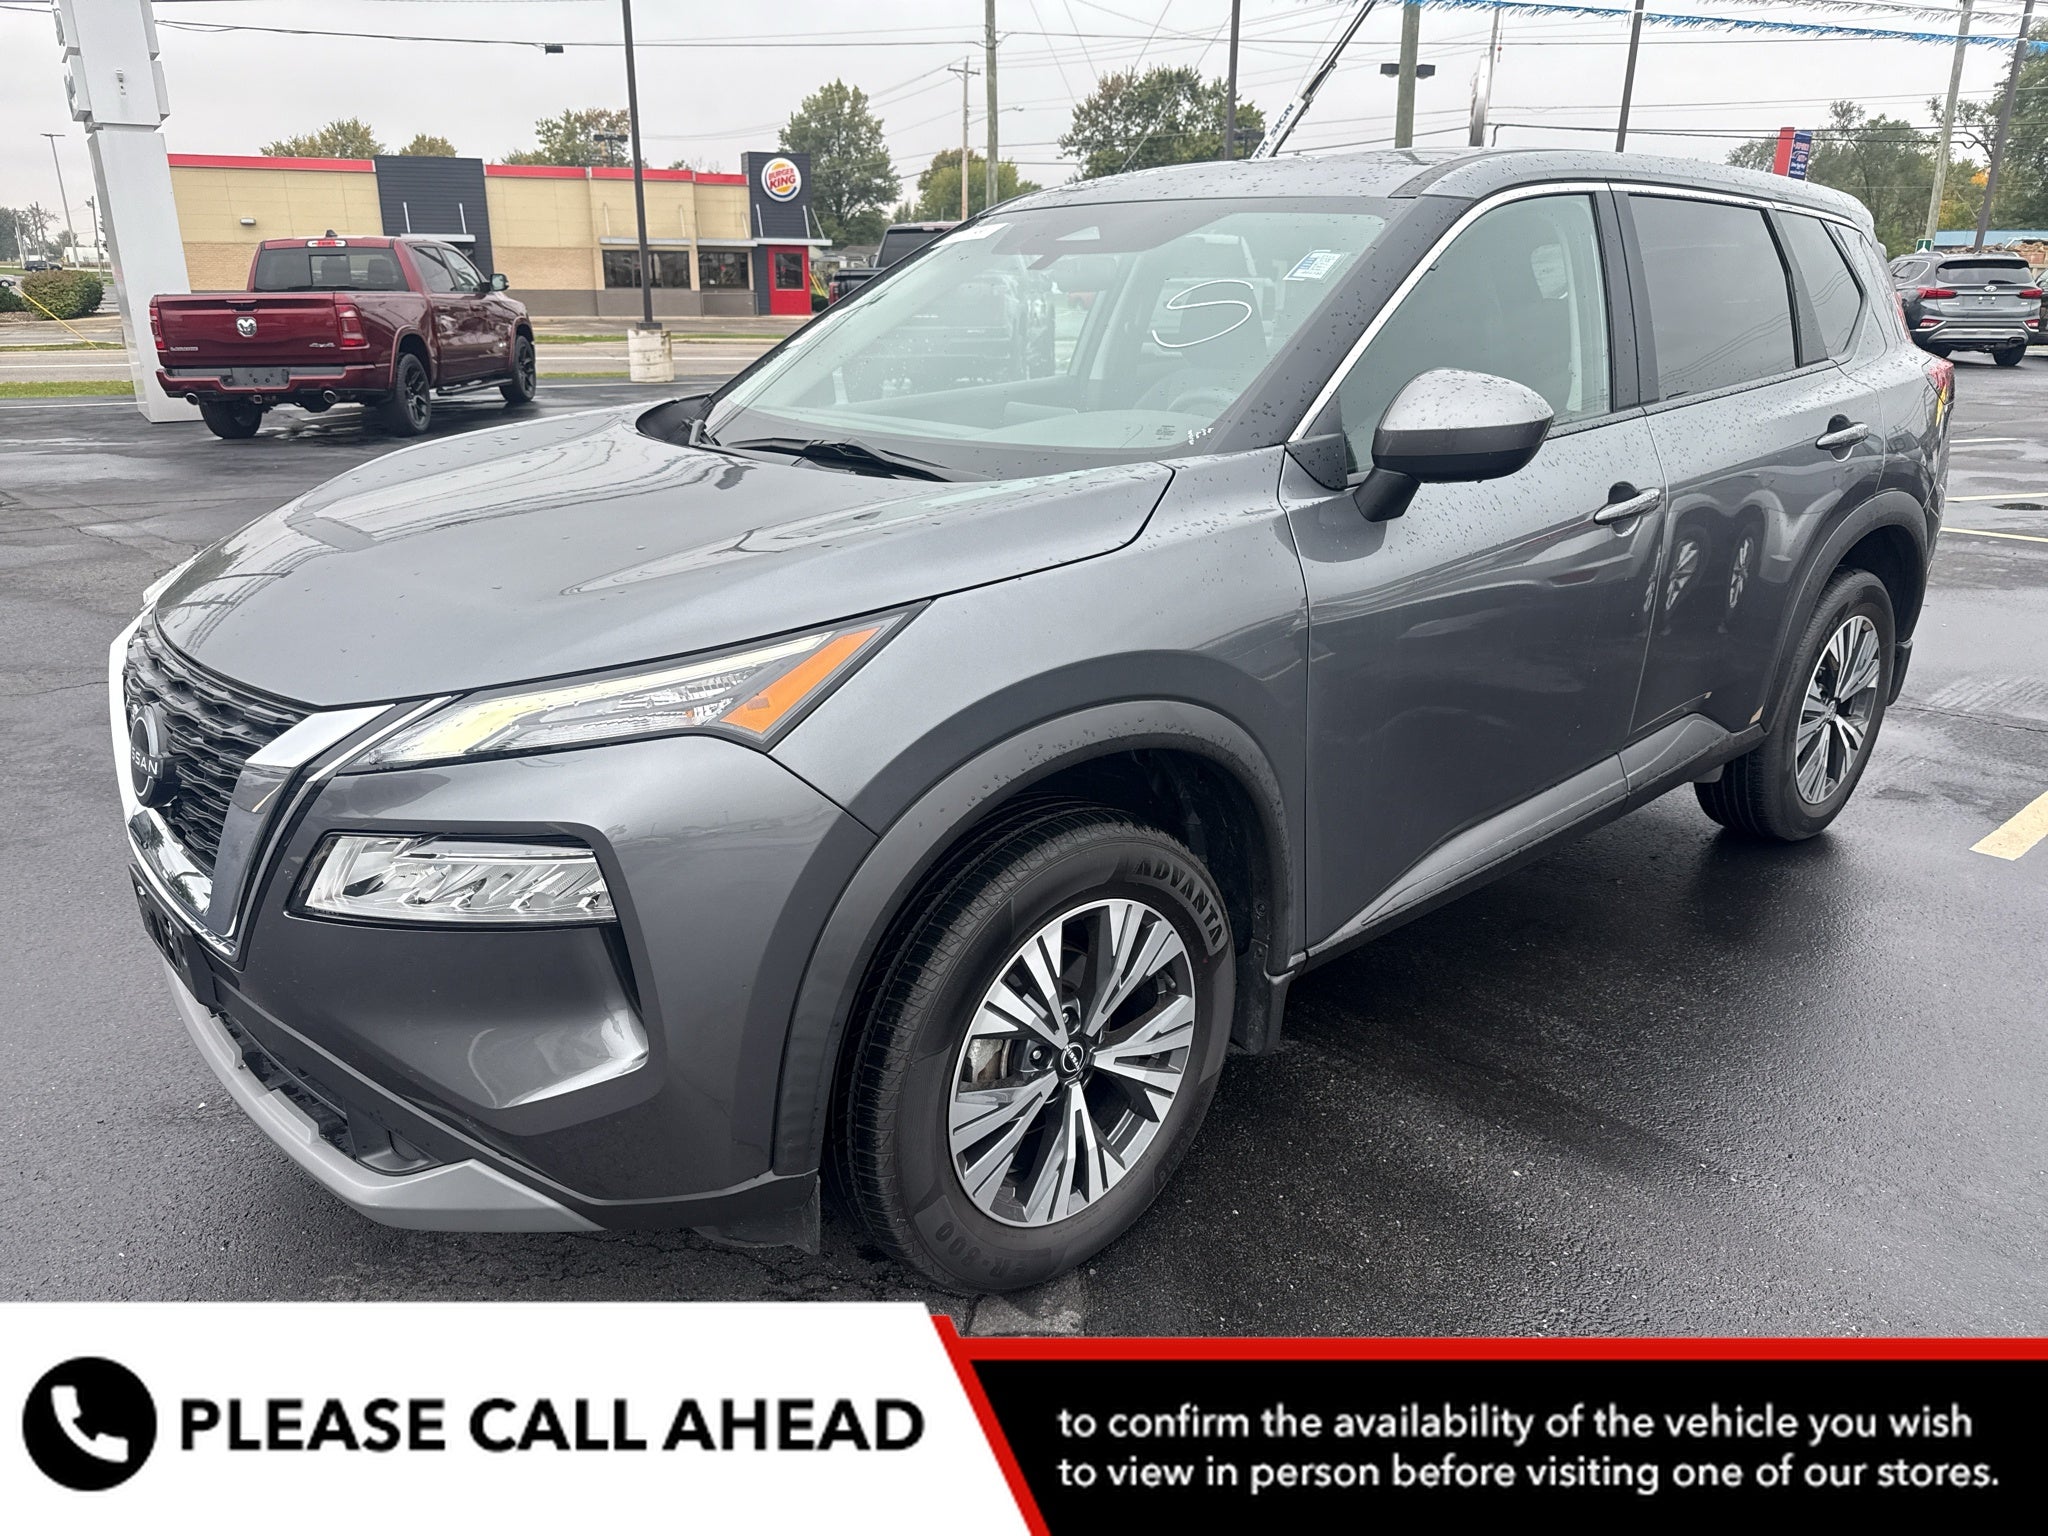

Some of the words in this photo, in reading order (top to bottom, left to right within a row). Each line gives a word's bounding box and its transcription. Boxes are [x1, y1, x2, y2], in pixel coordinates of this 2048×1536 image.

[1270, 103, 1295, 137] SIGN
[770, 174, 796, 189] KING
[1133, 859, 1225, 948] ADVANTA
[1064, 1044, 1081, 1071] NISSAN
